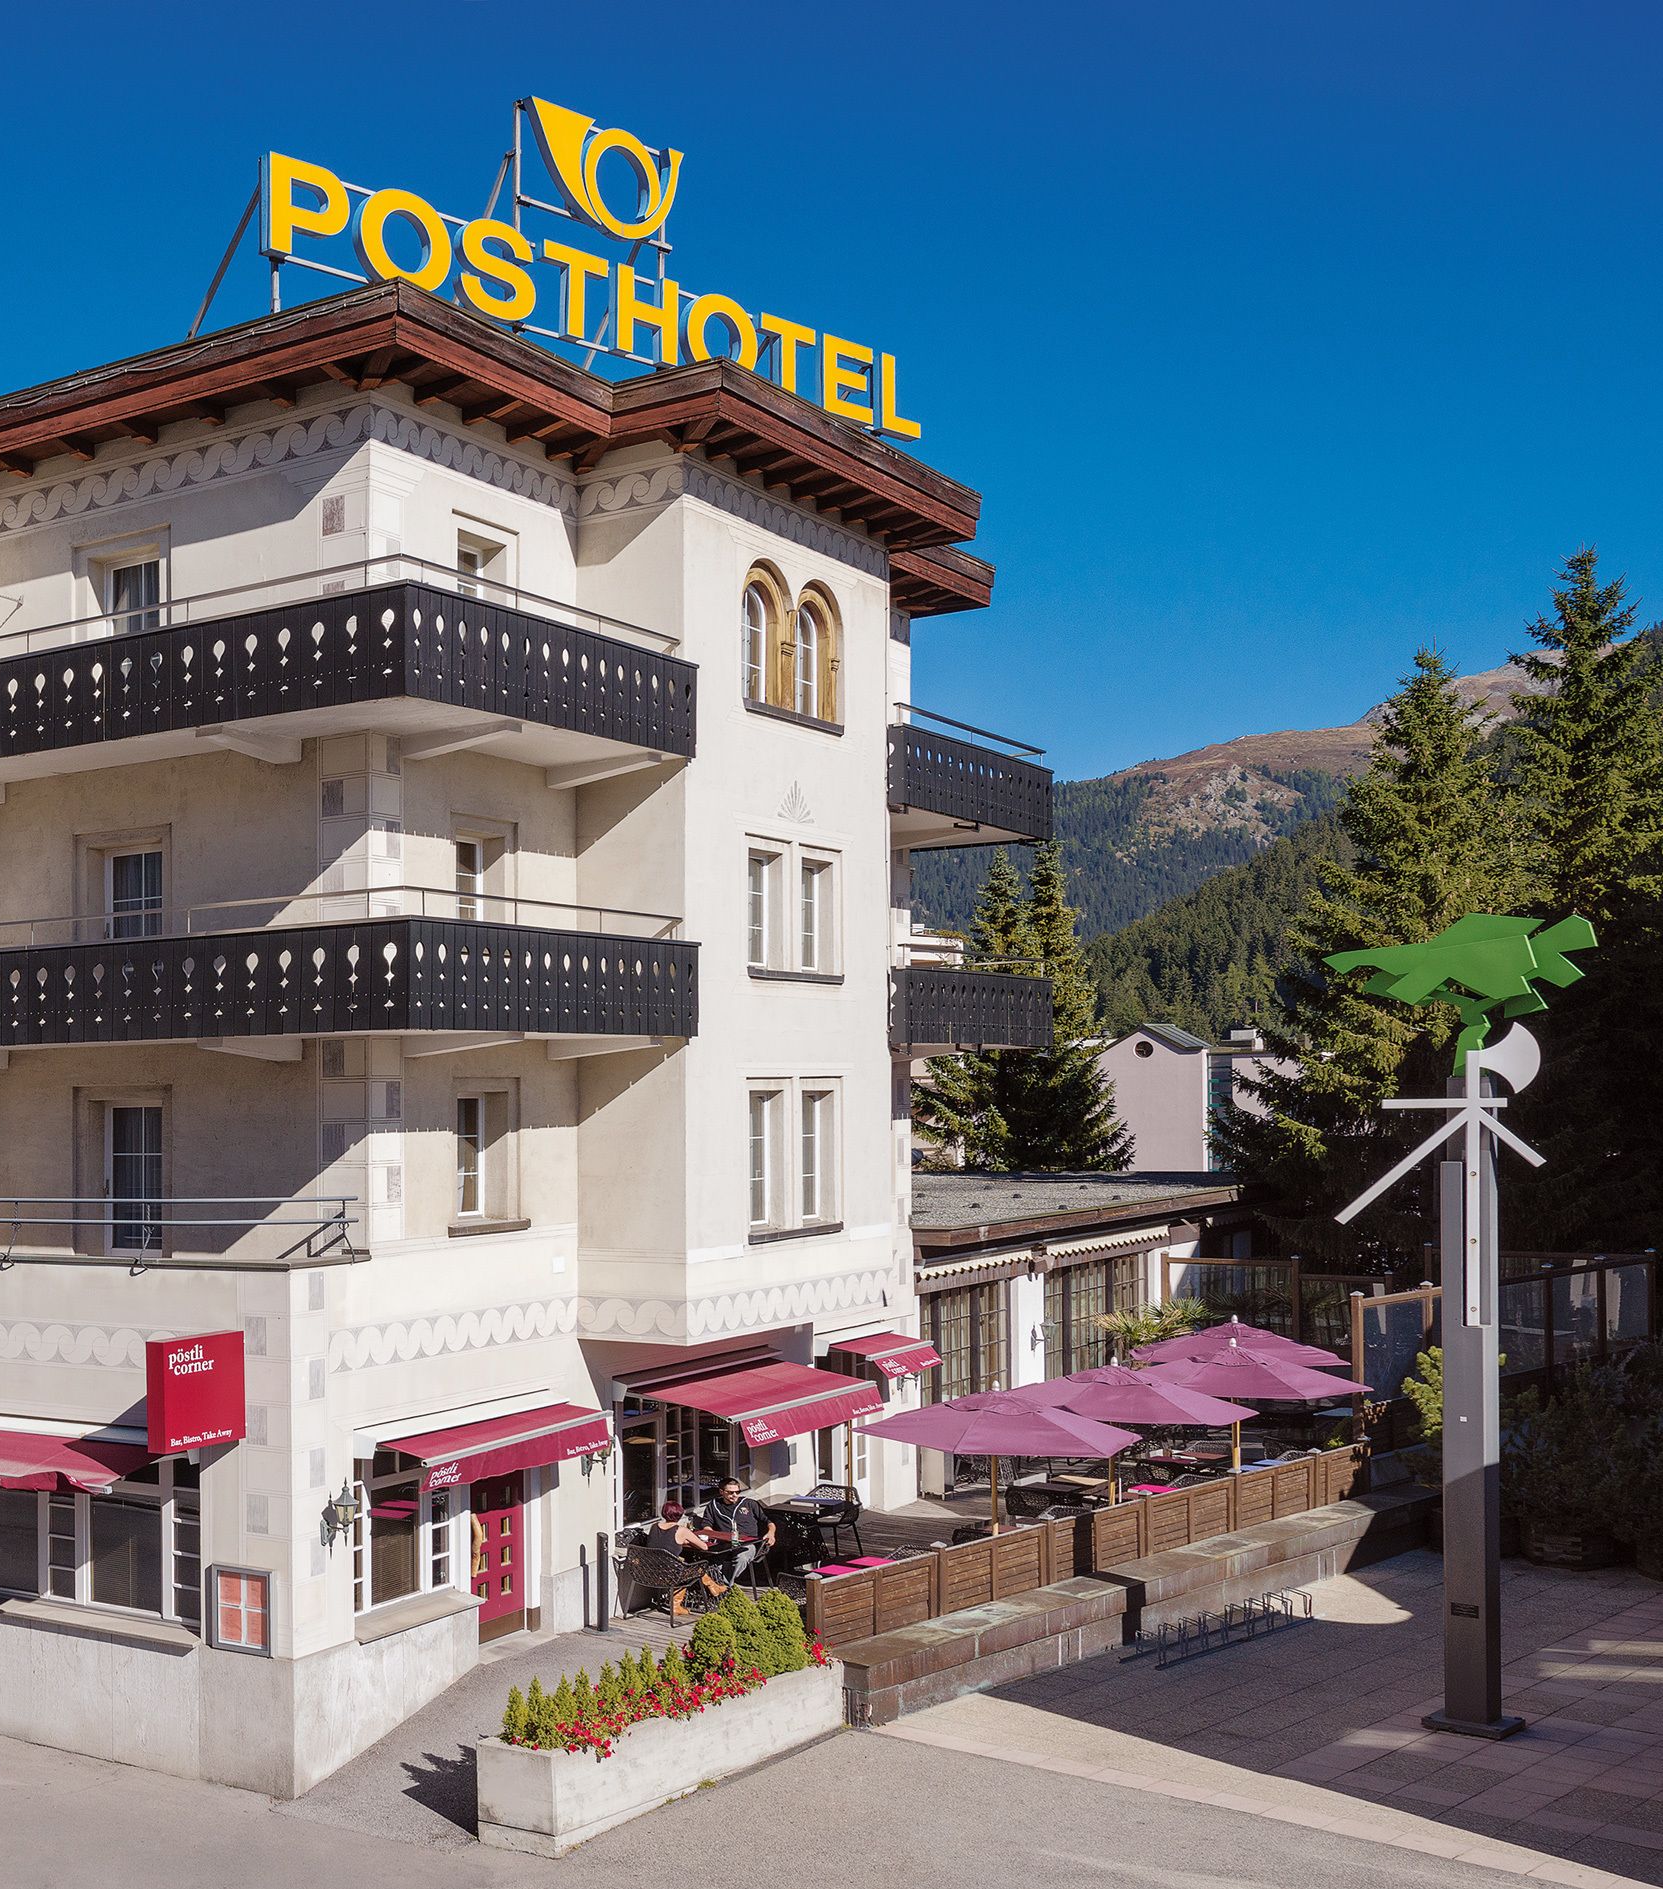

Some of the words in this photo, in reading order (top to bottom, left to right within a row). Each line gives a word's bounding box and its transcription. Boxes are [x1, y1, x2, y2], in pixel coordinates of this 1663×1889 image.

[259, 150, 922, 442] POSTHOTEL
[168, 1344, 203, 1370] pöstli
[174, 1359, 214, 1376] corner
[170, 1438, 183, 1447] Bar,
[183, 1434, 202, 1445] Bistro,
[202, 1430, 216, 1440] Take
[216, 1428, 233, 1438] Away
[746, 1419, 768, 1438] pöstli
[429, 1461, 459, 1484] pöstli
[429, 1472, 462, 1487] corner
